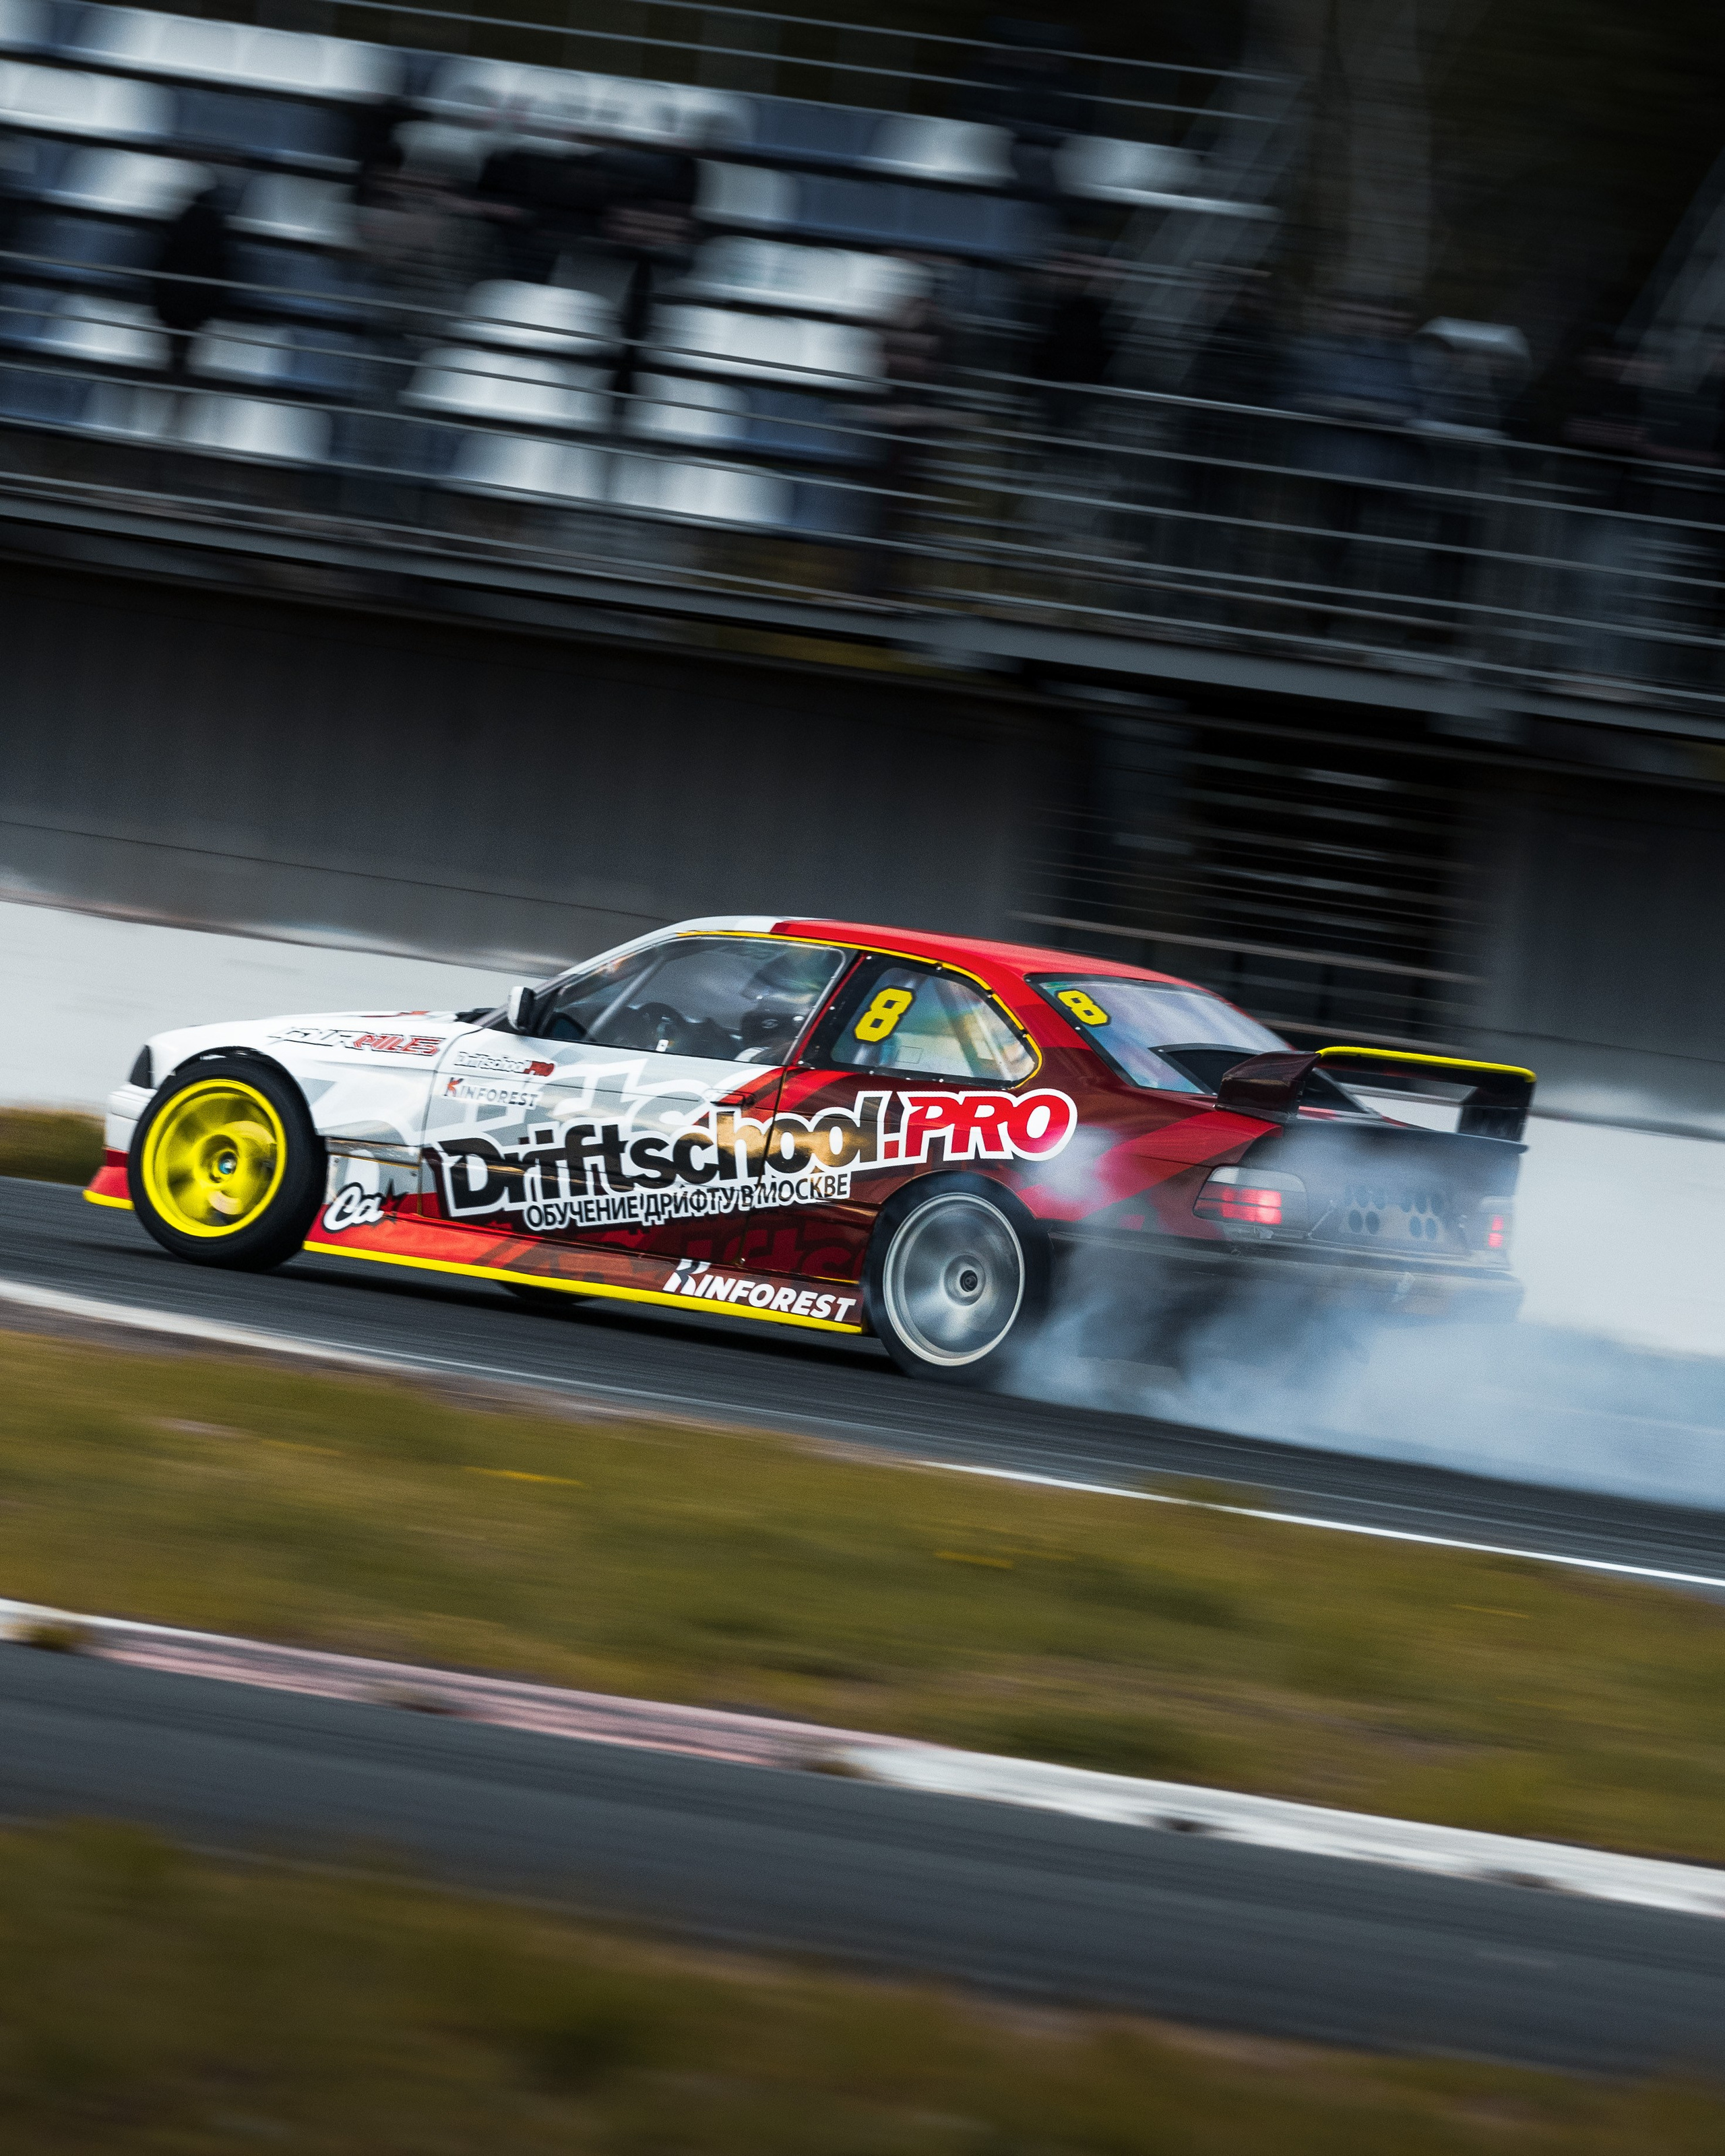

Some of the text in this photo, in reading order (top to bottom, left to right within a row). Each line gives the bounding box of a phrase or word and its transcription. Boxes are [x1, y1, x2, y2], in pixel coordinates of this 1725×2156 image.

[854, 988, 913, 1042] 8
[1057, 990, 1108, 1025] 8
[443, 1077, 538, 1106] KINFOREST
[436, 1091, 1073, 1212] Driftschool.PRO
[527, 1174, 848, 1228] ОБУЧЕНИЕ ДРИФТУ В МОСКВЕ
[662, 1259, 856, 1322] KINFOREST
